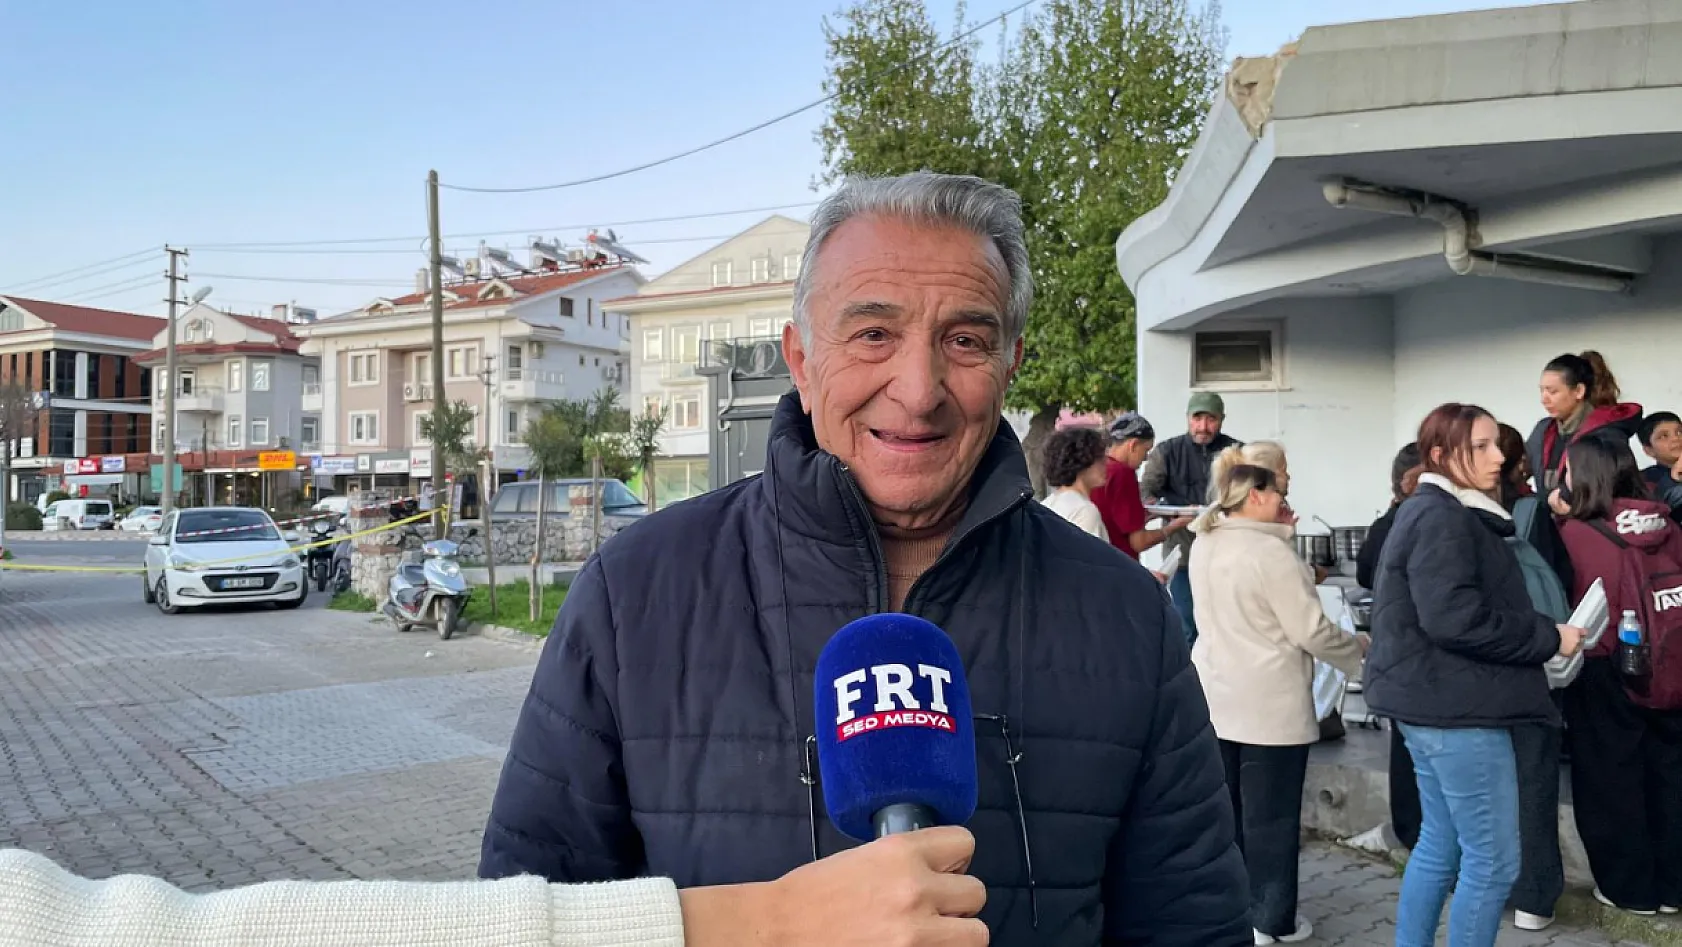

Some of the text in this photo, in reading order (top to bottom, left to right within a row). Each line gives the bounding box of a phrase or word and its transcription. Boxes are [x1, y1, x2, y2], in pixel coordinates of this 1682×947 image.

[833, 663, 952, 725] FRT
[842, 713, 951, 738] SED MEDYA
